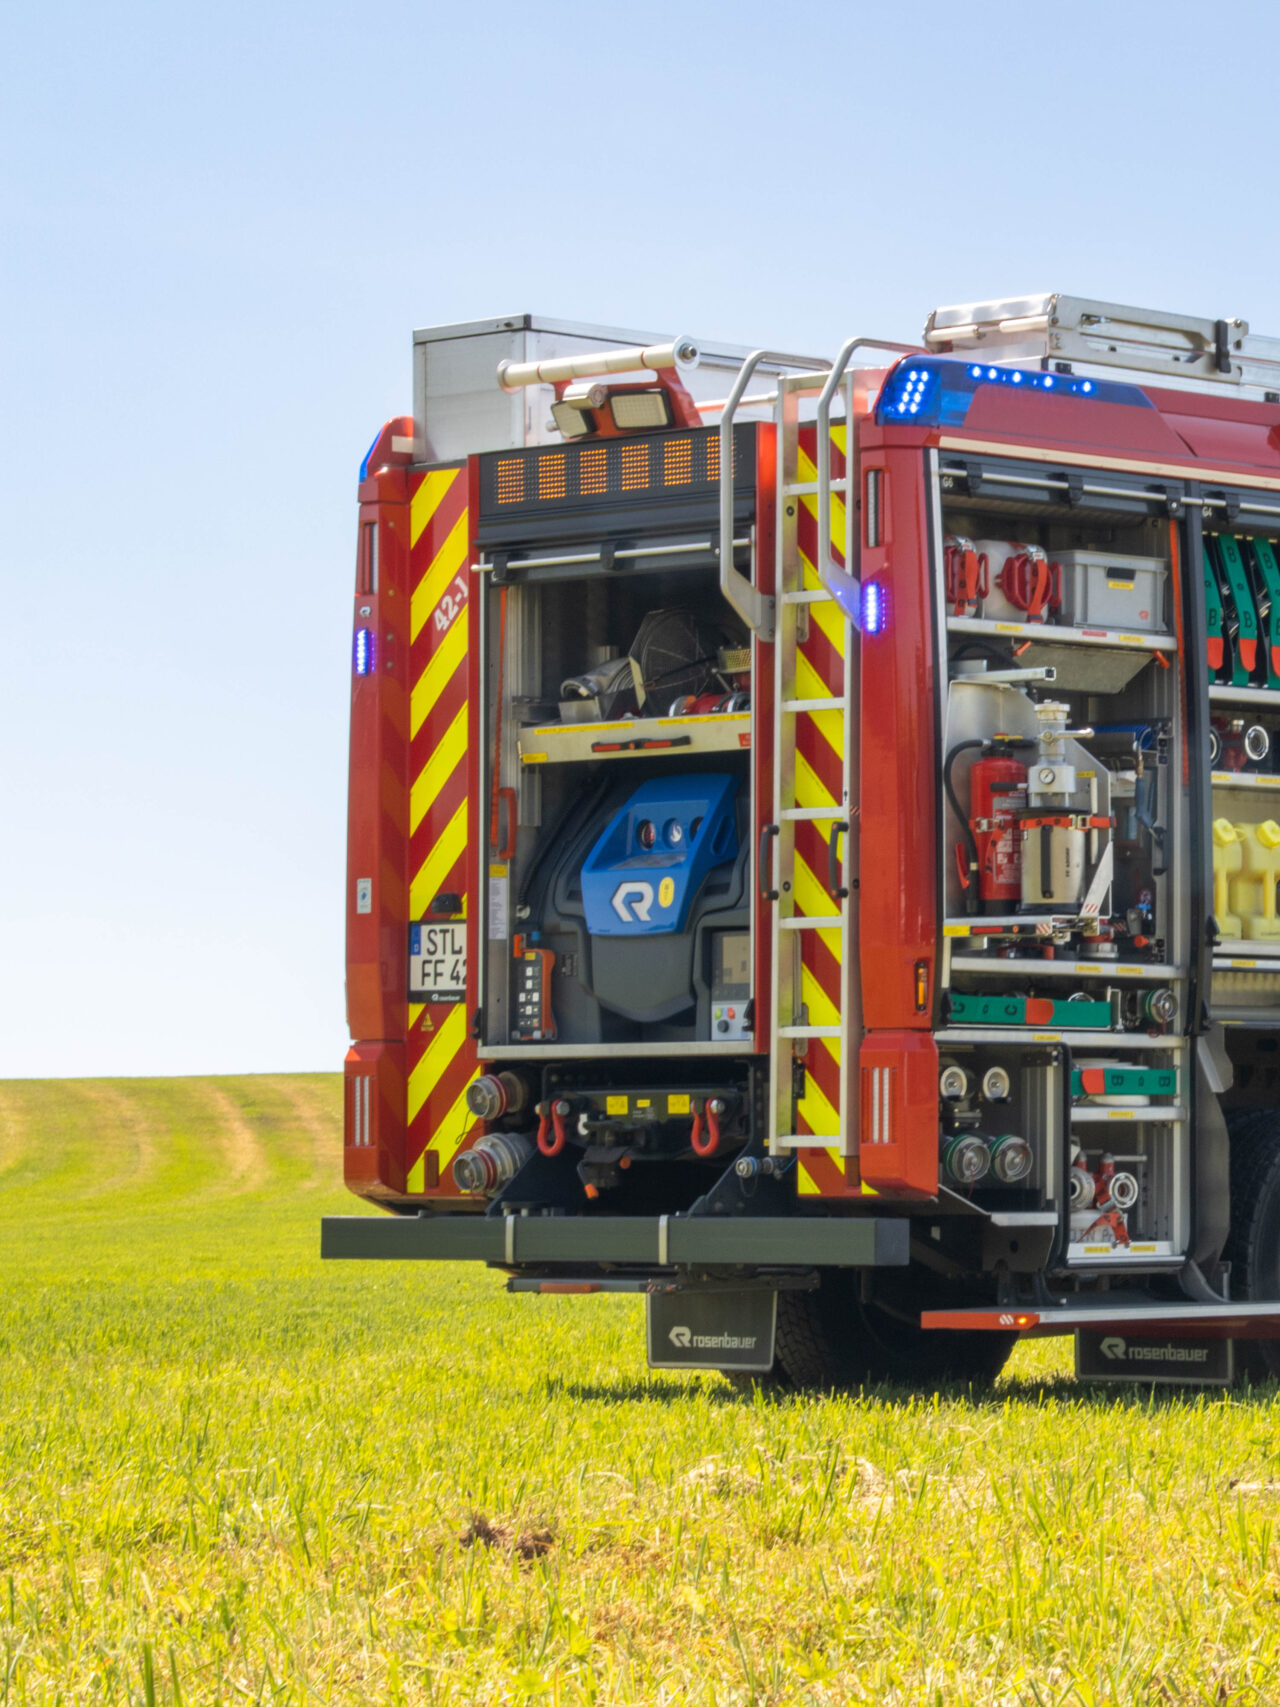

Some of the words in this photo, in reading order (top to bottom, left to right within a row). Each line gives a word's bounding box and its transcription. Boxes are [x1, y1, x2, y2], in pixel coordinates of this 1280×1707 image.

[426, 928, 462, 955] STL
[421, 959, 445, 986] FF
[693, 1331, 758, 1349] rosenbauer
[1128, 1343, 1209, 1362] rosenbauer
